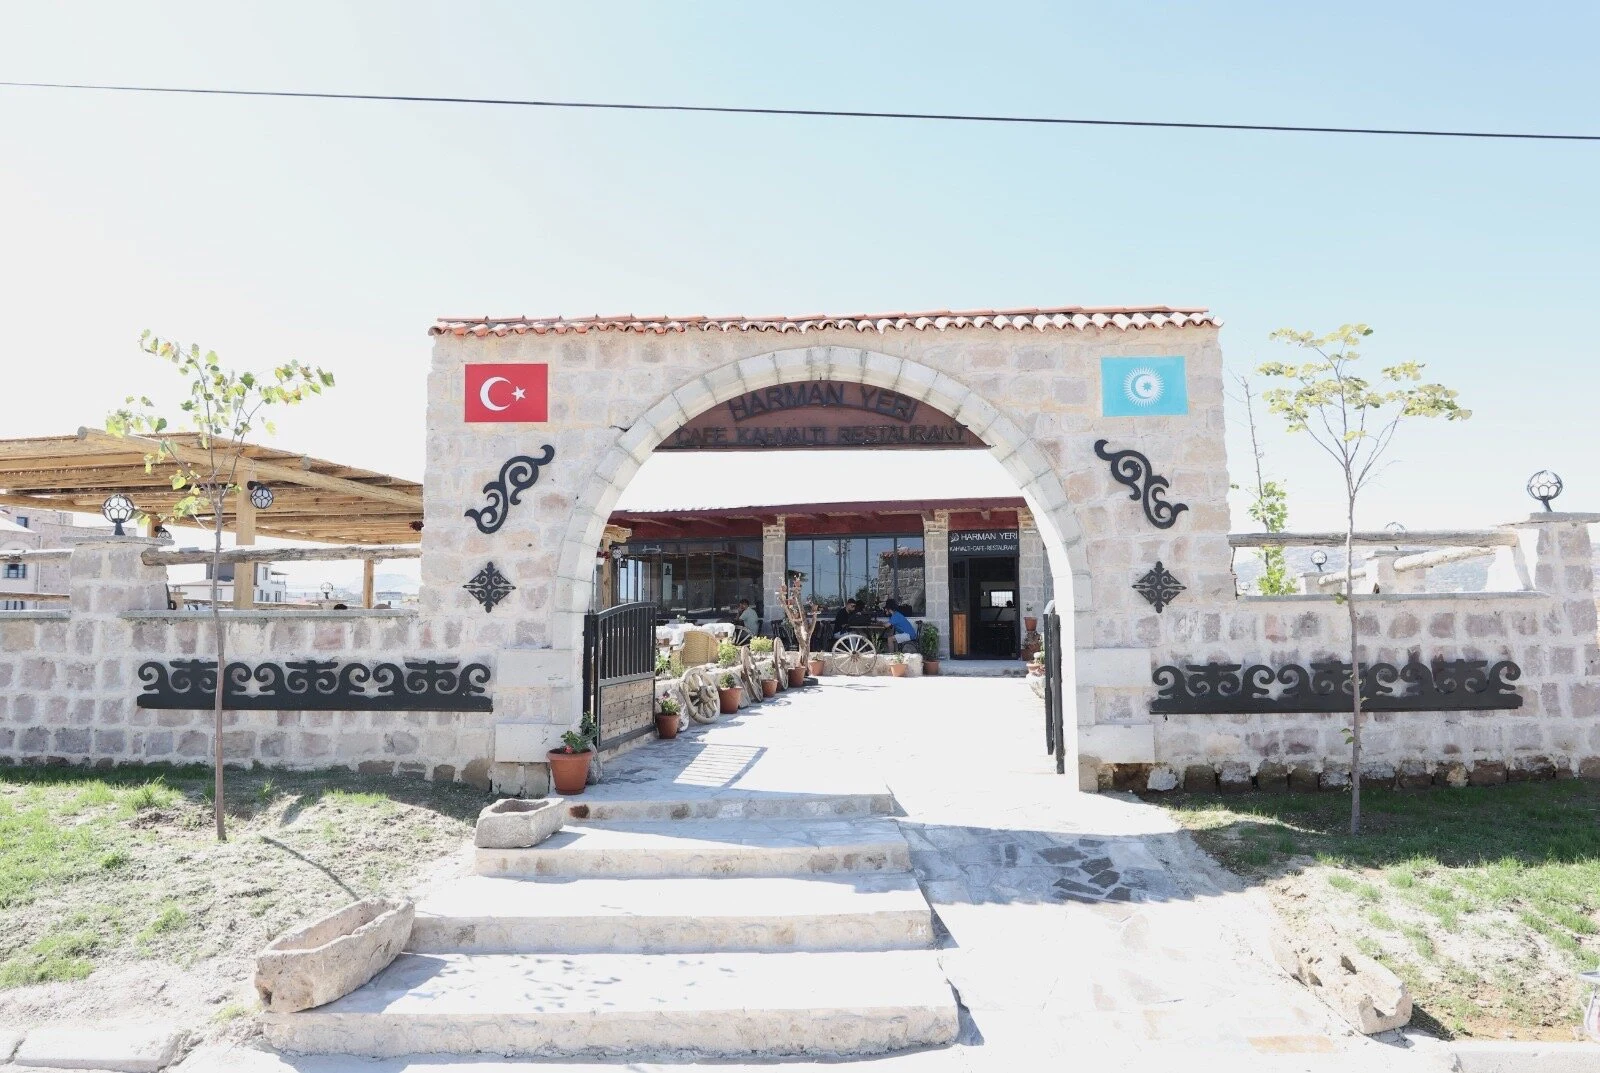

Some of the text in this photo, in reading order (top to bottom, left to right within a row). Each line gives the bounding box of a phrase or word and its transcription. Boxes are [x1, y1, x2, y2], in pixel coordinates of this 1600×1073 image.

[728, 382, 844, 422] HARMAN
[676, 426, 728, 445] CAFE
[839, 425, 968, 444] RESTAURANT
[961, 532, 996, 541] HARMAN
